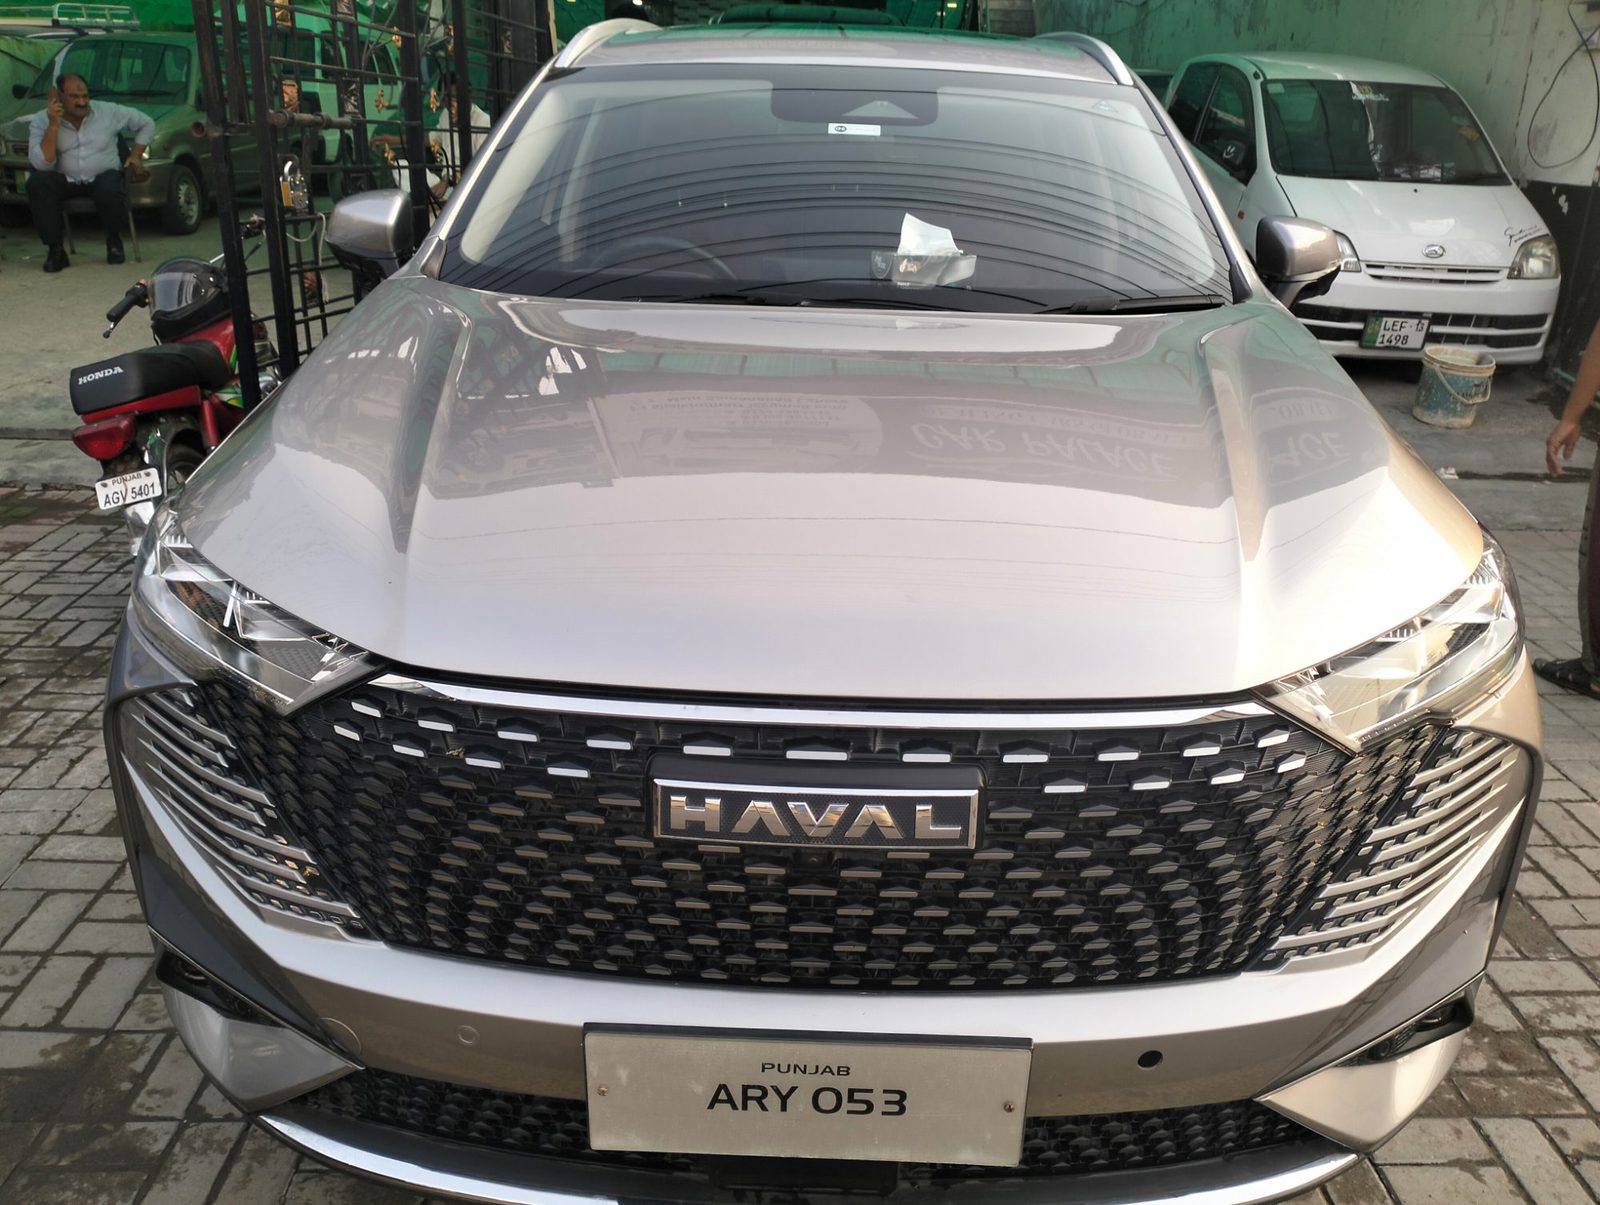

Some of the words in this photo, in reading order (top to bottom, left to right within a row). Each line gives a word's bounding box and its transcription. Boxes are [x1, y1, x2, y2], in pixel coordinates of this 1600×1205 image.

[1383, 320, 1408, 332] LEF
[1379, 335, 1409, 345] 1498
[78, 366, 124, 385] HONDA
[111, 472, 143, 486] PUNJAB
[103, 488, 129, 508] AGV
[131, 483, 156, 500] 5401
[669, 795, 962, 839] HAVAL
[761, 1062, 851, 1077] PUNJAB
[707, 1083, 799, 1113] ARY
[811, 1086, 908, 1117] 053
